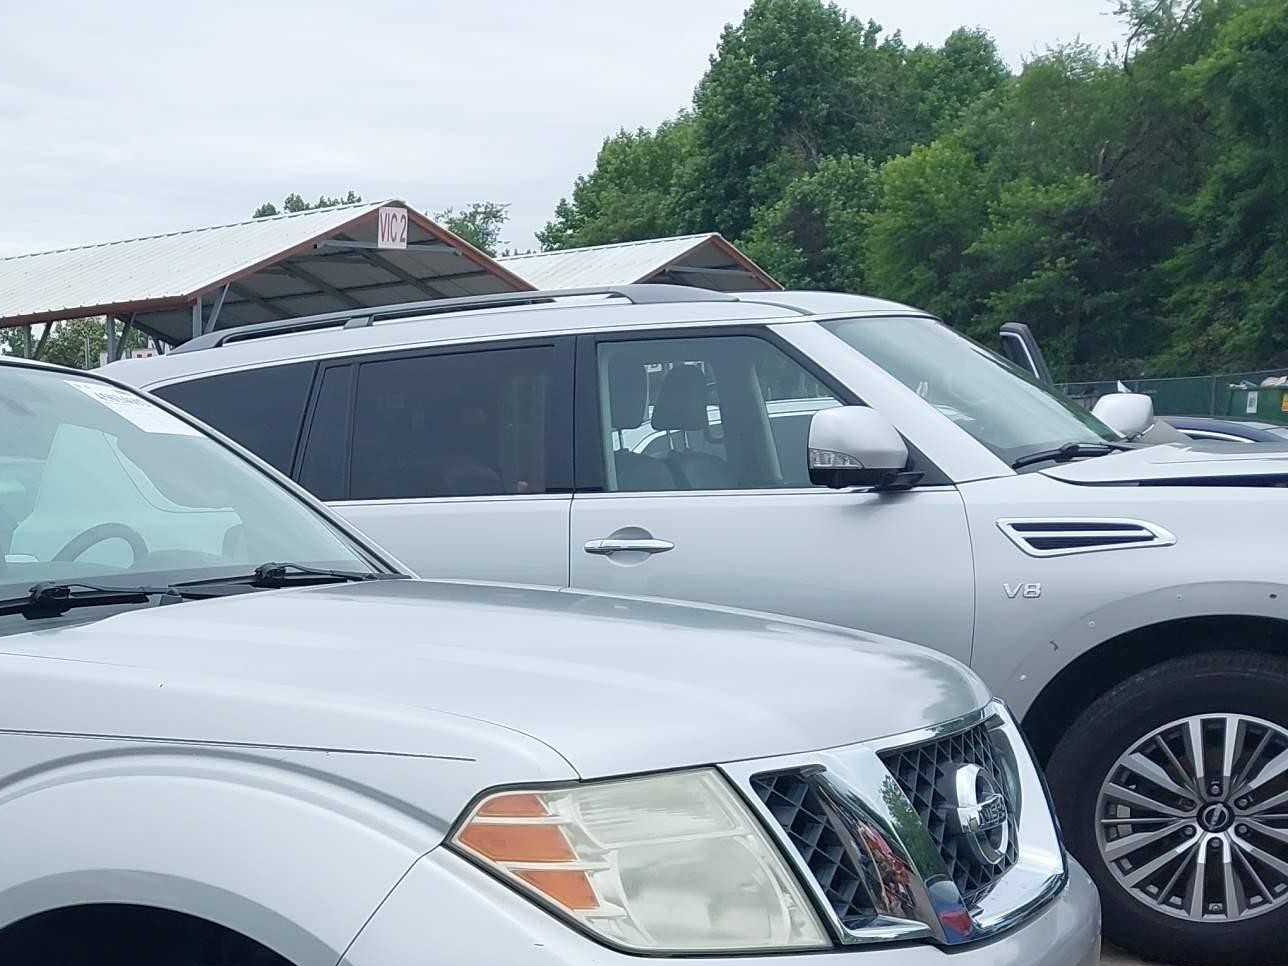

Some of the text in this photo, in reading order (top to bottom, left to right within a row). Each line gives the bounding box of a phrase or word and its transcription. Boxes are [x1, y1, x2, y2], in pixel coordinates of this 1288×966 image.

[379, 212, 407, 243] VIC 2
[1003, 582, 1042, 598] V8
